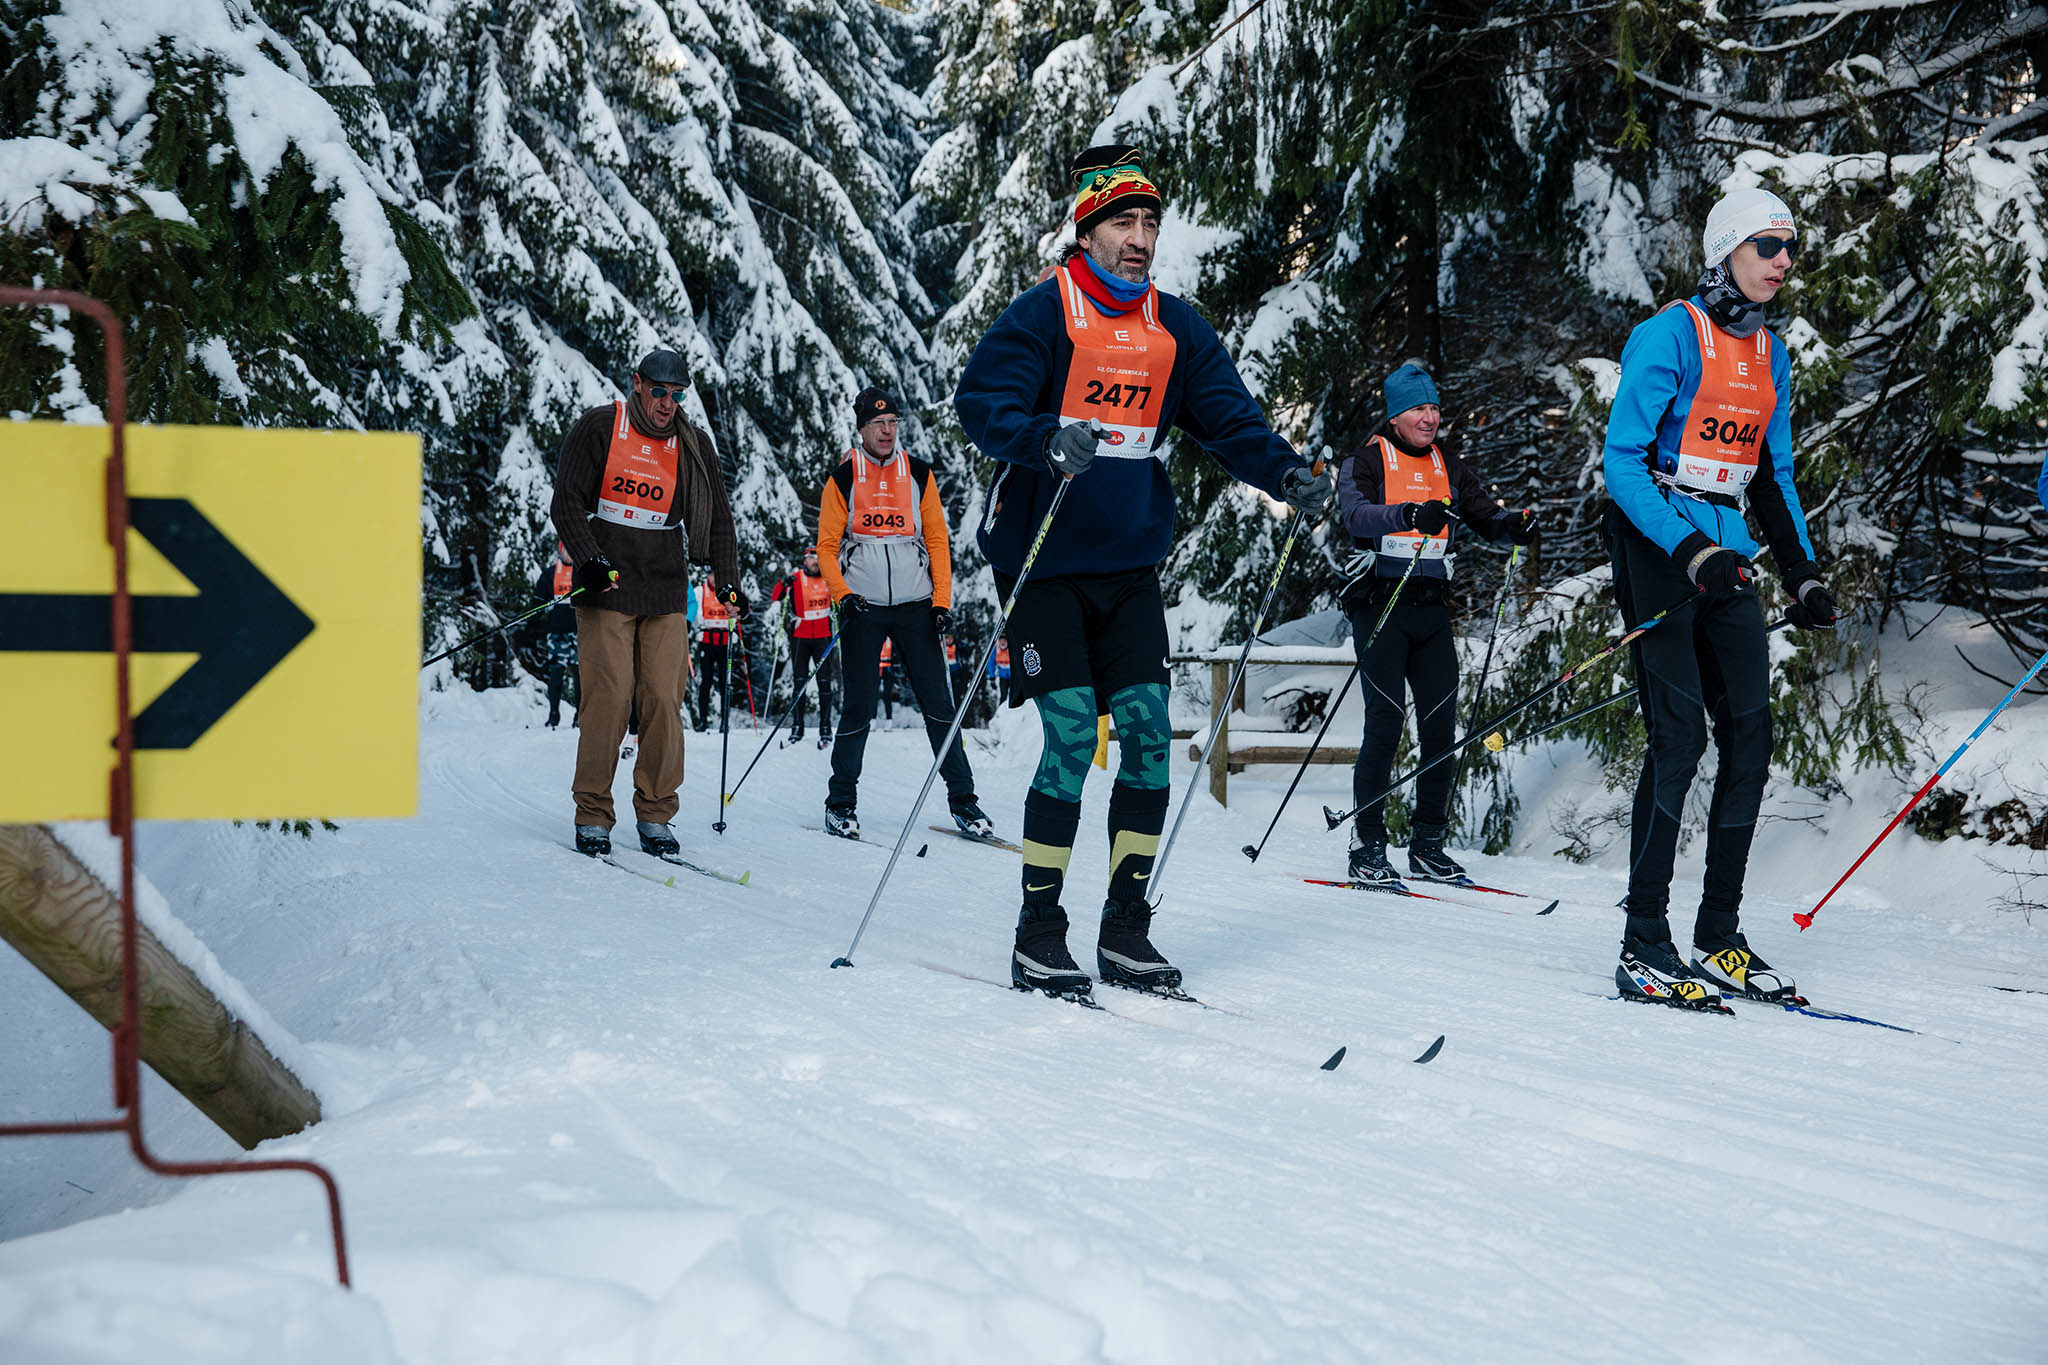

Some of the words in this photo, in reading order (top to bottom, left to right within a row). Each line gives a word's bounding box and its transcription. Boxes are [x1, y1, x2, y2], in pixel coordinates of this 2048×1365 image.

[1084, 380, 1152, 410] 2477
[1699, 416, 1760, 448] 3044
[612, 476, 664, 501] 2500
[862, 513, 905, 528] 3043
